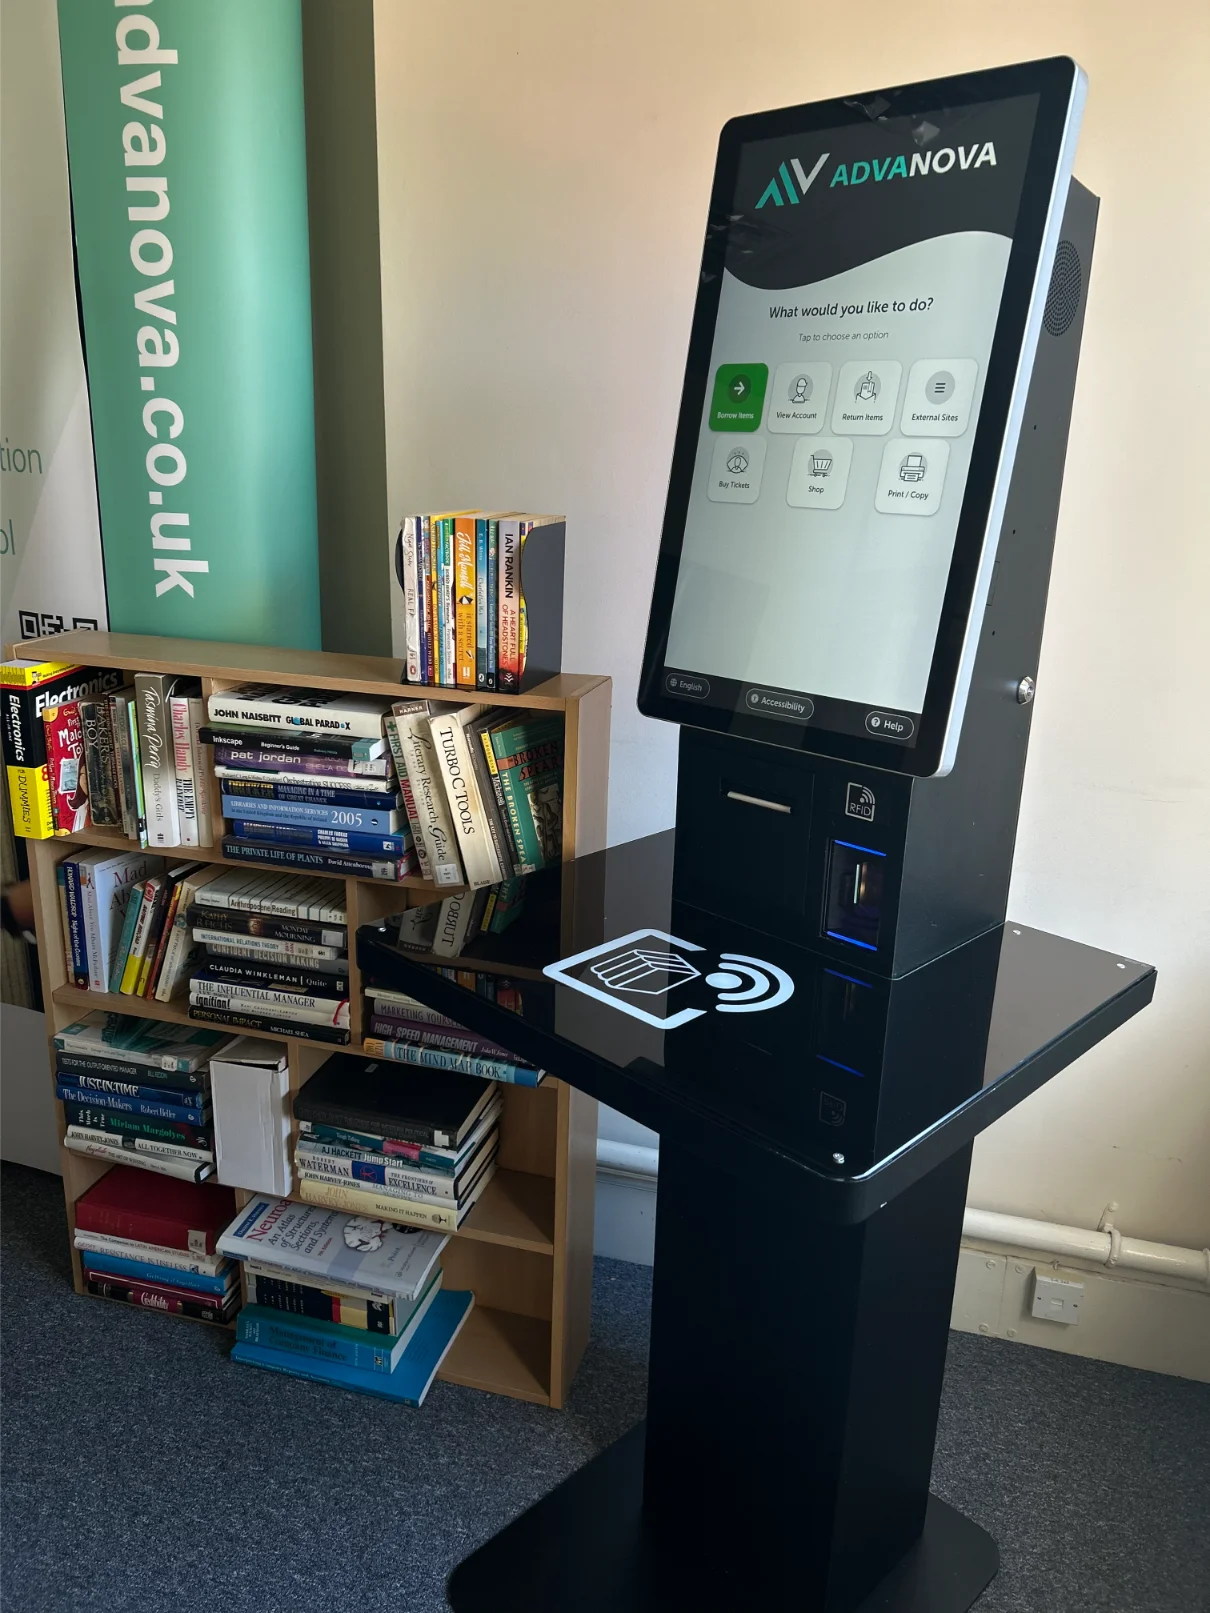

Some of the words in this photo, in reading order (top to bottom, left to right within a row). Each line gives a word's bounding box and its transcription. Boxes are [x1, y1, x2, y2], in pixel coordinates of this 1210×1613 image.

[829, 141, 998, 188] ADVANOVA
[114, 0, 210, 599] dvanova.co.uk
[769, 306, 798, 318] What
[801, 303, 838, 317] would
[840, 305, 863, 318] you
[867, 300, 889, 313] like
[892, 300, 906, 312] to
[909, 297, 934, 312] do?
[798, 333, 811, 342] Tap
[812, 333, 821, 341] to
[822, 331, 850, 341] choose
[862, 331, 889, 342] option
[717, 411, 737, 419] Borrow
[738, 411, 754, 419] Items
[776, 411, 790, 419] View
[791, 411, 817, 420] Account
[842, 413, 864, 422] Return
[865, 413, 883, 422] Items
[911, 413, 940, 422] External
[941, 413, 959, 422] Sites
[0, 437, 43, 475] tion
[718, 480, 730, 489] Buy
[730, 481, 750, 489] Tickets
[808, 485, 824, 494] Shop
[888, 489, 904, 498] Print
[910, 491, 929, 500] Copy
[0, 518, 16, 556] ol
[456, 532, 472, 553] Jill
[504, 533, 514, 552] IAN
[458, 553, 474, 589] Mansell
[504, 554, 515, 599] RANKIN
[501, 604, 508, 614] OF
[457, 612, 465, 629] with
[465, 620, 474, 649] started
[457, 637, 465, 662] secret
[35, 671, 119, 718] Electronics
[679, 680, 703, 692] English
[141, 686, 162, 733] Tasmina
[760, 696, 806, 714] Accessibility
[172, 703, 188, 740] Charles
[213, 708, 239, 719] JOHN
[241, 711, 281, 724] NAISBITT
[884, 720, 904, 732] Help
[8, 694, 26, 763] Electronics
[86, 719, 99, 749] BOY
[96, 702, 110, 764] BAKER'S
[142, 733, 163, 769] Perry
[212, 735, 243, 746] Inkscape
[260, 741, 285, 750] Beginner's
[388, 733, 402, 757] FIRST
[406, 727, 432, 777] Literary
[439, 726, 461, 777] TURBO
[175, 743, 191, 773] Handy
[230, 751, 253, 761] pat
[257, 751, 301, 764] jordan
[396, 757, 408, 778] AID
[152, 773, 162, 802] Daddy's
[182, 777, 193, 792] THE
[451, 776, 466, 790] C
[18, 773, 31, 823] DUMMIES
[184, 795, 195, 820] EMPTY
[399, 778, 419, 821] MANUAL
[420, 776, 440, 825] Research
[501, 771, 512, 792] THE
[507, 795, 521, 836] BROKEN
[155, 803, 164, 822] Girls
[330, 810, 363, 827] 2005
[455, 790, 476, 835] TOOLS
[849, 802, 872, 817] RFID
[427, 824, 447, 861] Guide
[226, 844, 241, 854] THE
[241, 846, 270, 858] PRIVATE
[270, 850, 285, 860] LIFE
[285, 852, 296, 861] OF
[297, 853, 324, 865] PLANTS
[327, 859, 343, 867] David
[113, 860, 148, 889] Mad
[201, 909, 229, 920] KATHY
[230, 899, 272, 912] Anthropocene
[271, 904, 296, 917] Reading
[196, 918, 233, 931] REICHS
[281, 923, 308, 933] MONDAY
[200, 933, 236, 944] INTERNATIONAL
[236, 937, 261, 948] RELATIONS
[261, 941, 279, 950] THEORY
[274, 930, 316, 943] MOURNING
[253, 949, 287, 965] DECISION
[289, 953, 320, 969] MAKING
[209, 964, 243, 975] CLAUDIA
[245, 969, 298, 983] WINKLEMAN
[306, 978, 328, 987] Quite
[195, 994, 231, 1010] ignition!
[197, 981, 214, 992] THE
[216, 983, 271, 1001] INFLUENTIAL
[273, 993, 316, 1008] MANAGER
[193, 1009, 230, 1023] PERSONAL
[232, 1015, 263, 1028] IMPACT
[380, 1004, 424, 1021] MARKETING
[373, 1022, 394, 1036] HIGH
[395, 1026, 421, 1042] SPEED
[421, 1031, 479, 1053] MANAGEMENT
[396, 1046, 418, 1062] THE
[418, 1050, 448, 1068] MIND
[448, 1057, 472, 1074] MAP
[474, 1061, 501, 1078] BOOK
[77, 1075, 140, 1098] JUST-IN-TIME
[62, 1087, 77, 1101] The
[77, 1090, 133, 1112] Decision-Makers
[140, 1104, 159, 1117] Robert
[159, 1107, 177, 1119] Heller
[109, 1117, 141, 1132] Miriam
[142, 1124, 186, 1141] Margolyes
[137, 1142, 148, 1152] ALL
[148, 1143, 182, 1157] TOGETHER
[182, 1149, 198, 1160] NOW
[312, 1155, 336, 1164] ROBERT
[321, 1146, 331, 1155] AJ
[331, 1148, 362, 1161] HACKETT
[299, 1158, 350, 1177] WATERMAN
[400, 1173, 428, 1183] FRONTIERS
[304, 1171, 319, 1181] JOHN
[319, 1174, 361, 1188] HARVEY-JONES
[388, 1177, 437, 1196] EXCELLENCE
[305, 1192, 369, 1213] HARVEY-JONES
[325, 1186, 349, 1198] JOHN
[375, 1203, 397, 1213] MAKING
[404, 1208, 427, 1219] HAPPEN
[268, 1231, 282, 1246] An
[278, 1213, 296, 1235] Atlas
[290, 1220, 320, 1252] Sections,
[280, 1237, 290, 1248] of
[304, 1237, 318, 1254] and
[100, 1247, 145, 1263] RESISTANCE
[154, 1258, 187, 1271] USELESS
[269, 1325, 324, 1348] Management
[269, 1336, 311, 1357] Company
[312, 1346, 347, 1362] Finance
